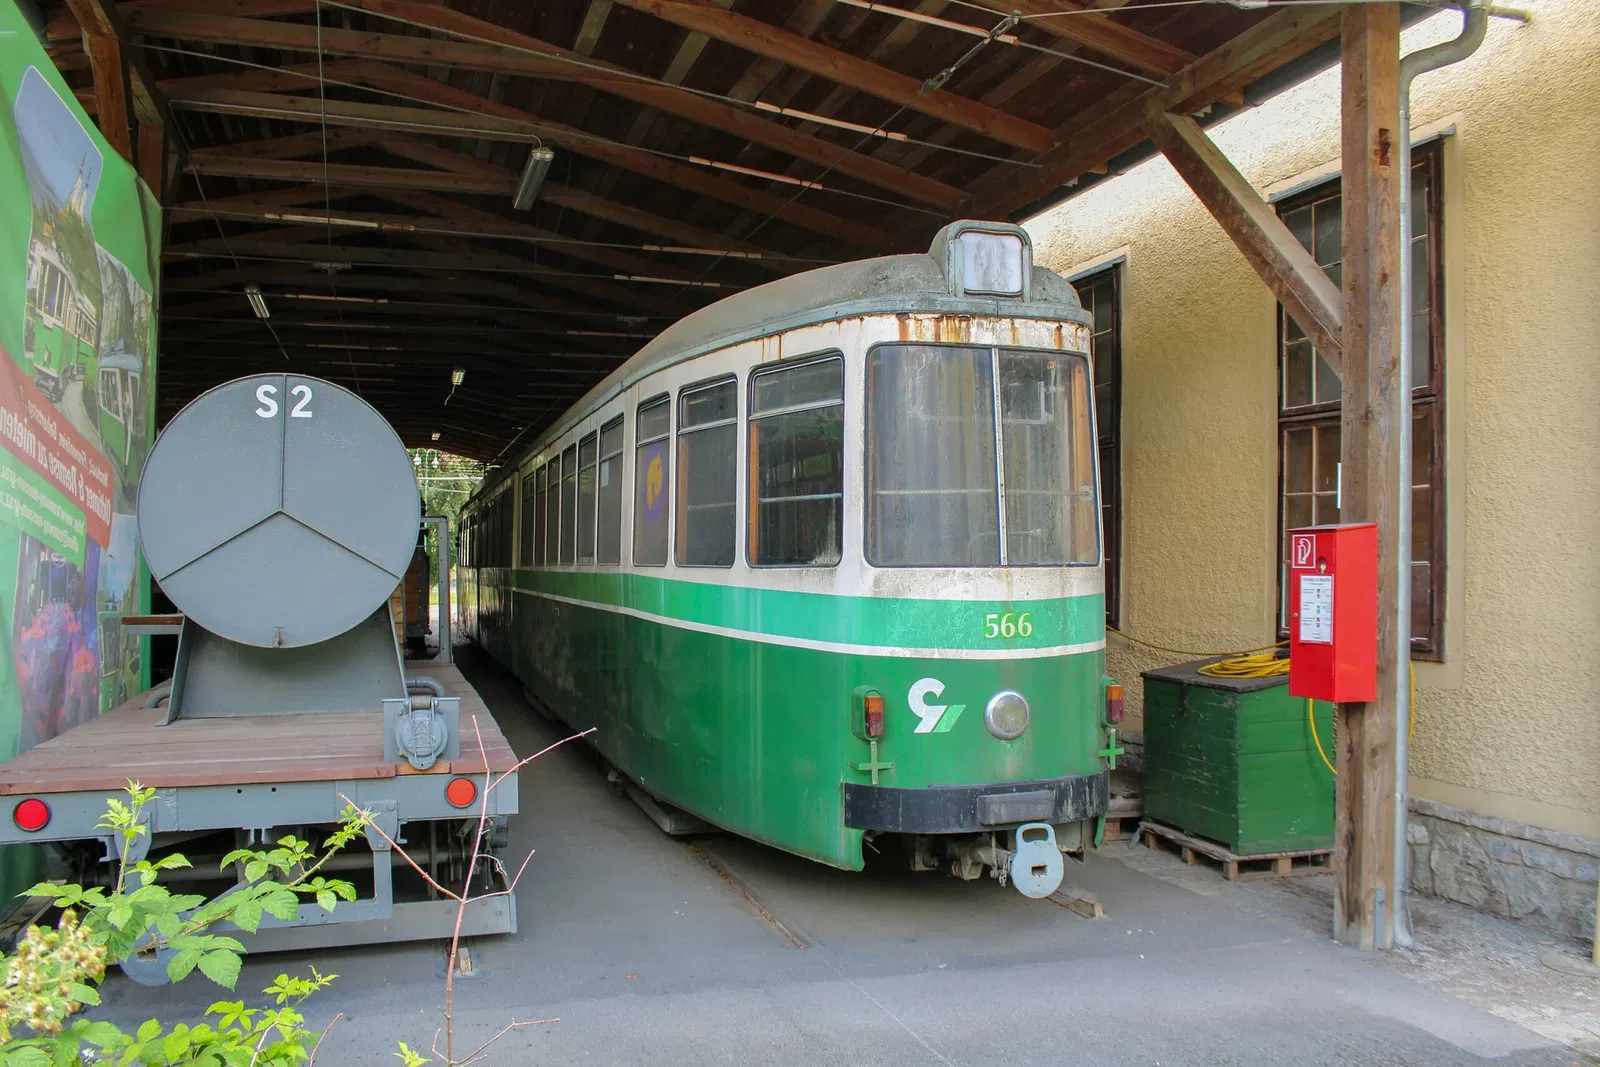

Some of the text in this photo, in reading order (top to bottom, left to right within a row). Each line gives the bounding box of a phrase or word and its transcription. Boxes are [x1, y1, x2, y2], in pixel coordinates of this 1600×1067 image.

[255, 384, 313, 419] S 2
[984, 612, 1033, 639] 566
